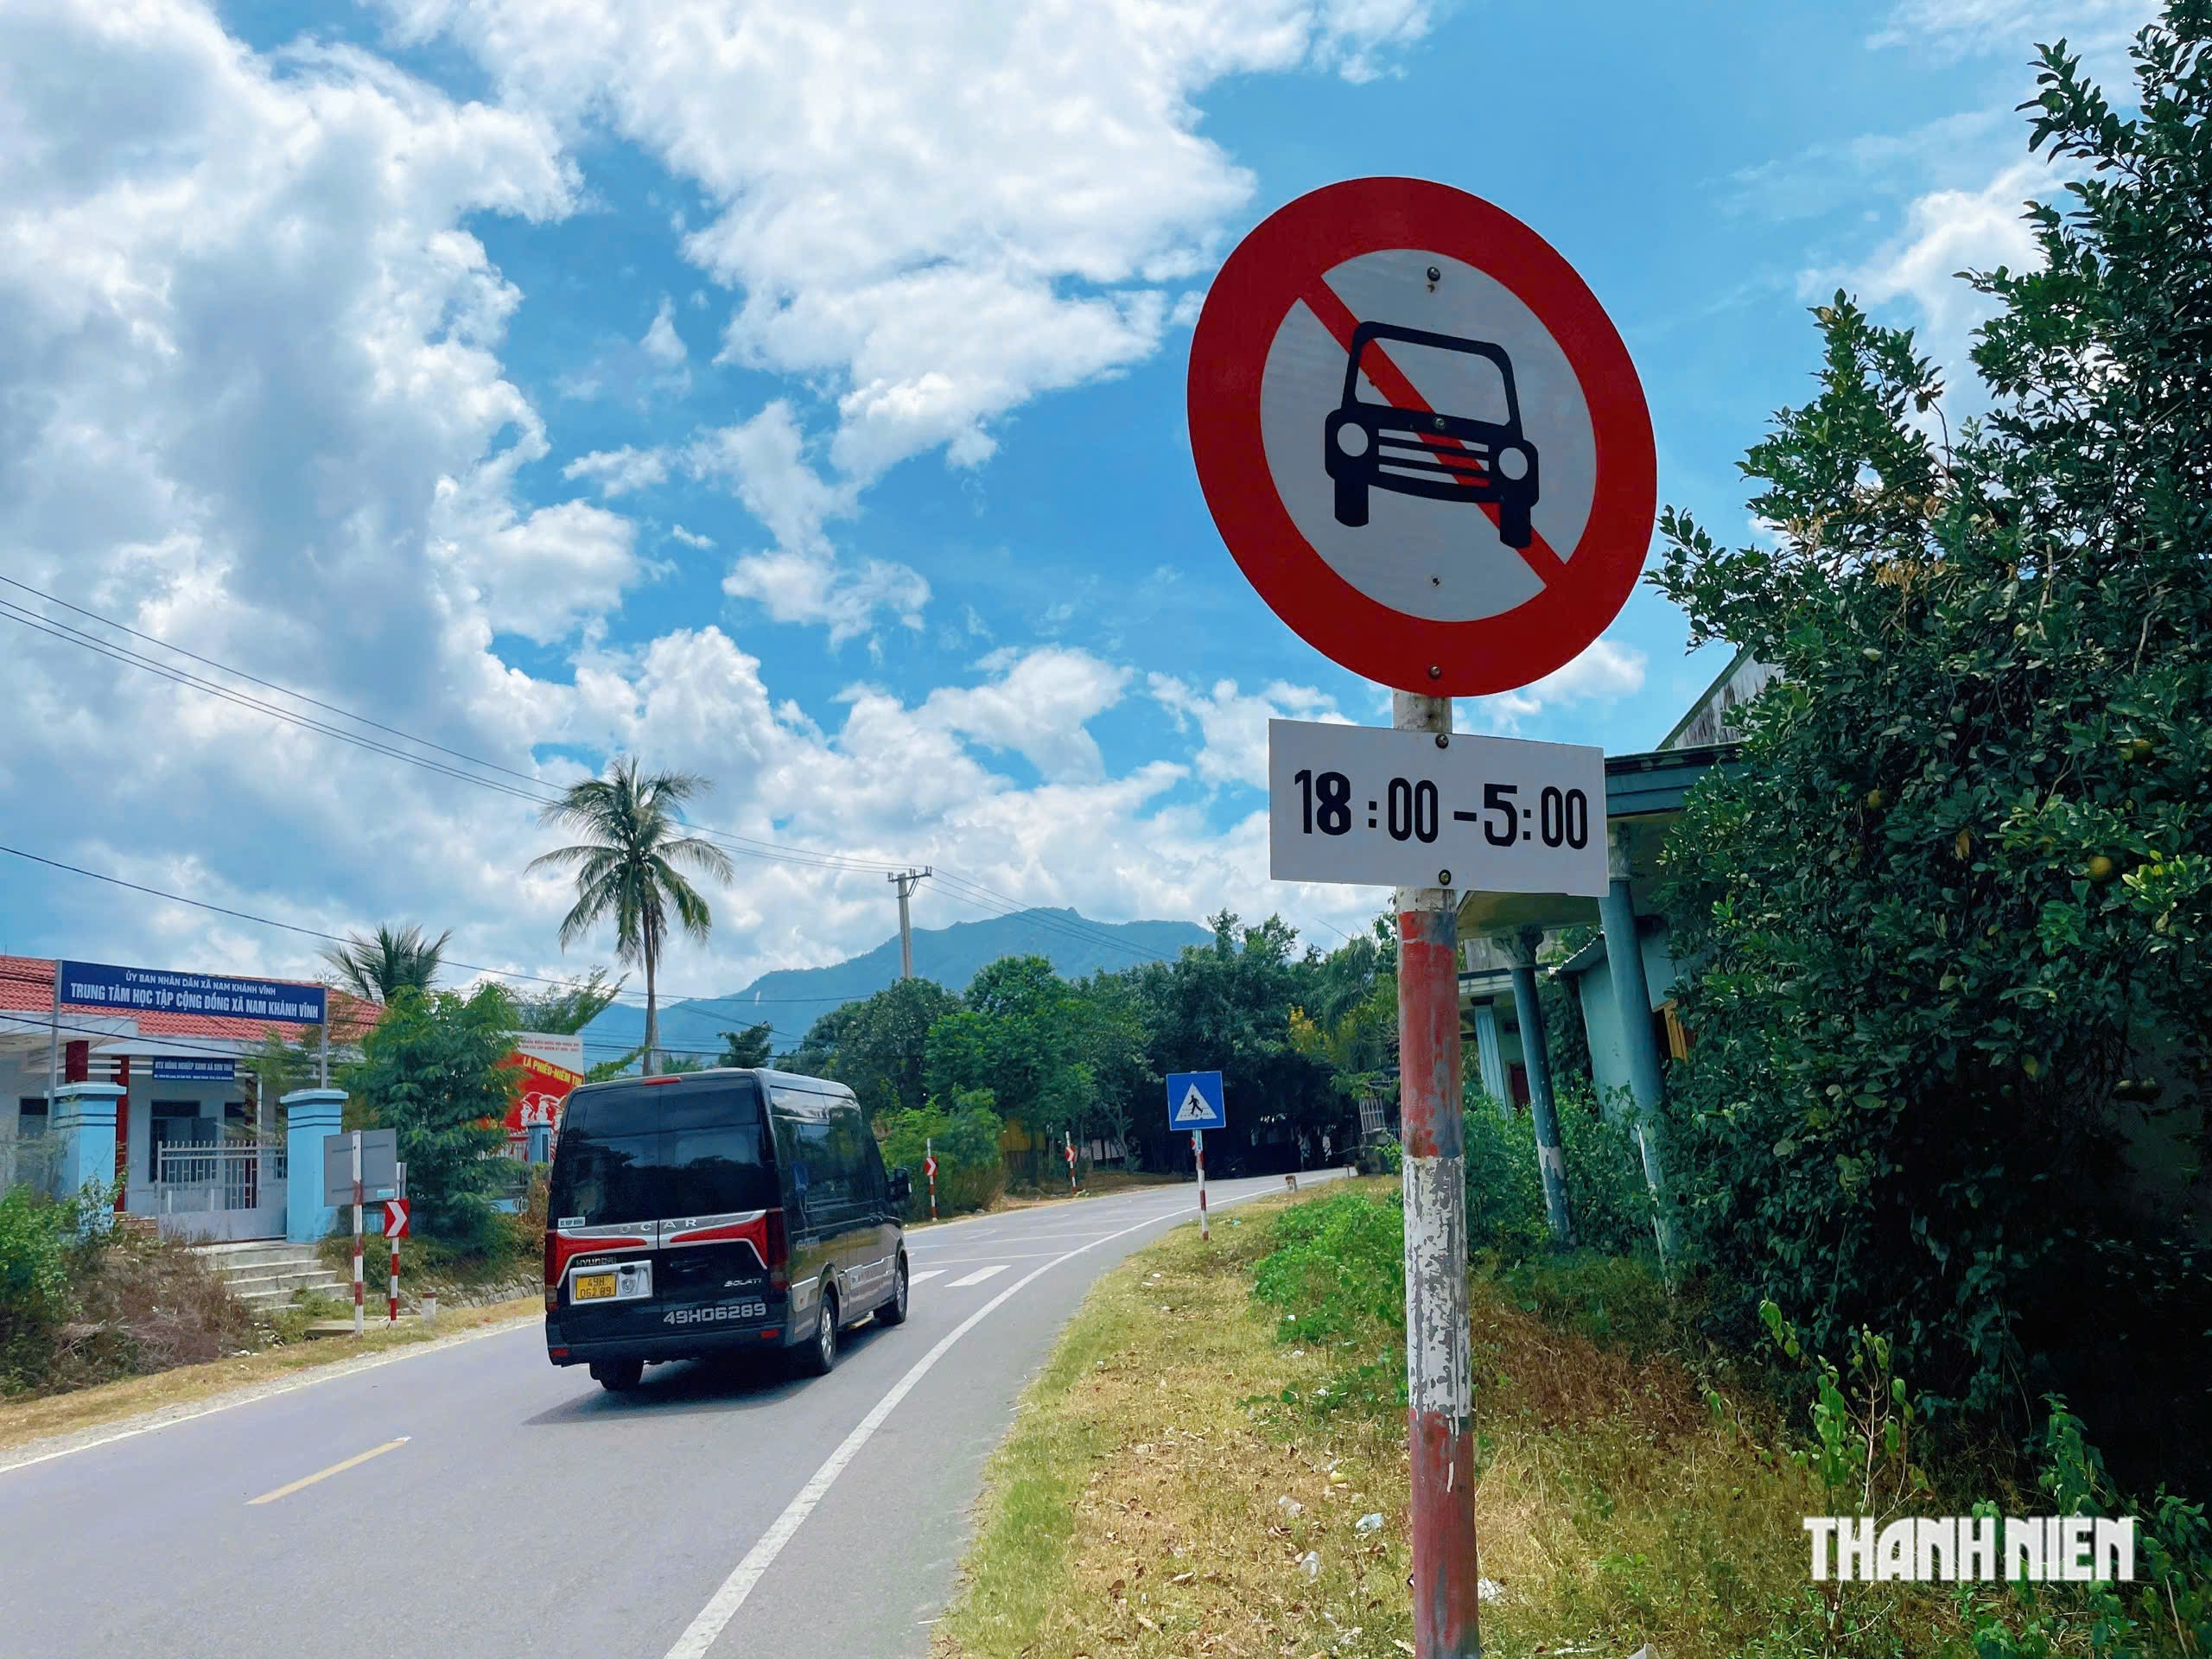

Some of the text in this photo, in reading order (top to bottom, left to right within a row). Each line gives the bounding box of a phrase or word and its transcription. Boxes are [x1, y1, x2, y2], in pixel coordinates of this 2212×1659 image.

[139, 974, 156, 983] BAN
[157, 975, 181, 987] NHÂN
[182, 976, 199, 988] DÂN
[200, 979, 212, 989] XÃ
[213, 982, 231, 991] NAM
[232, 982, 257, 994] KHÁNH
[258, 985, 276, 996] VĨNH
[71, 982, 319, 1019] TRUNG TÂM HỌC TẬP CỘNG ĐỒNG XÃ NAM KHÁNH VĨNH
[723, 1278, 762, 1287] SOLATI
[663, 1302, 766, 1325] 49H06289
